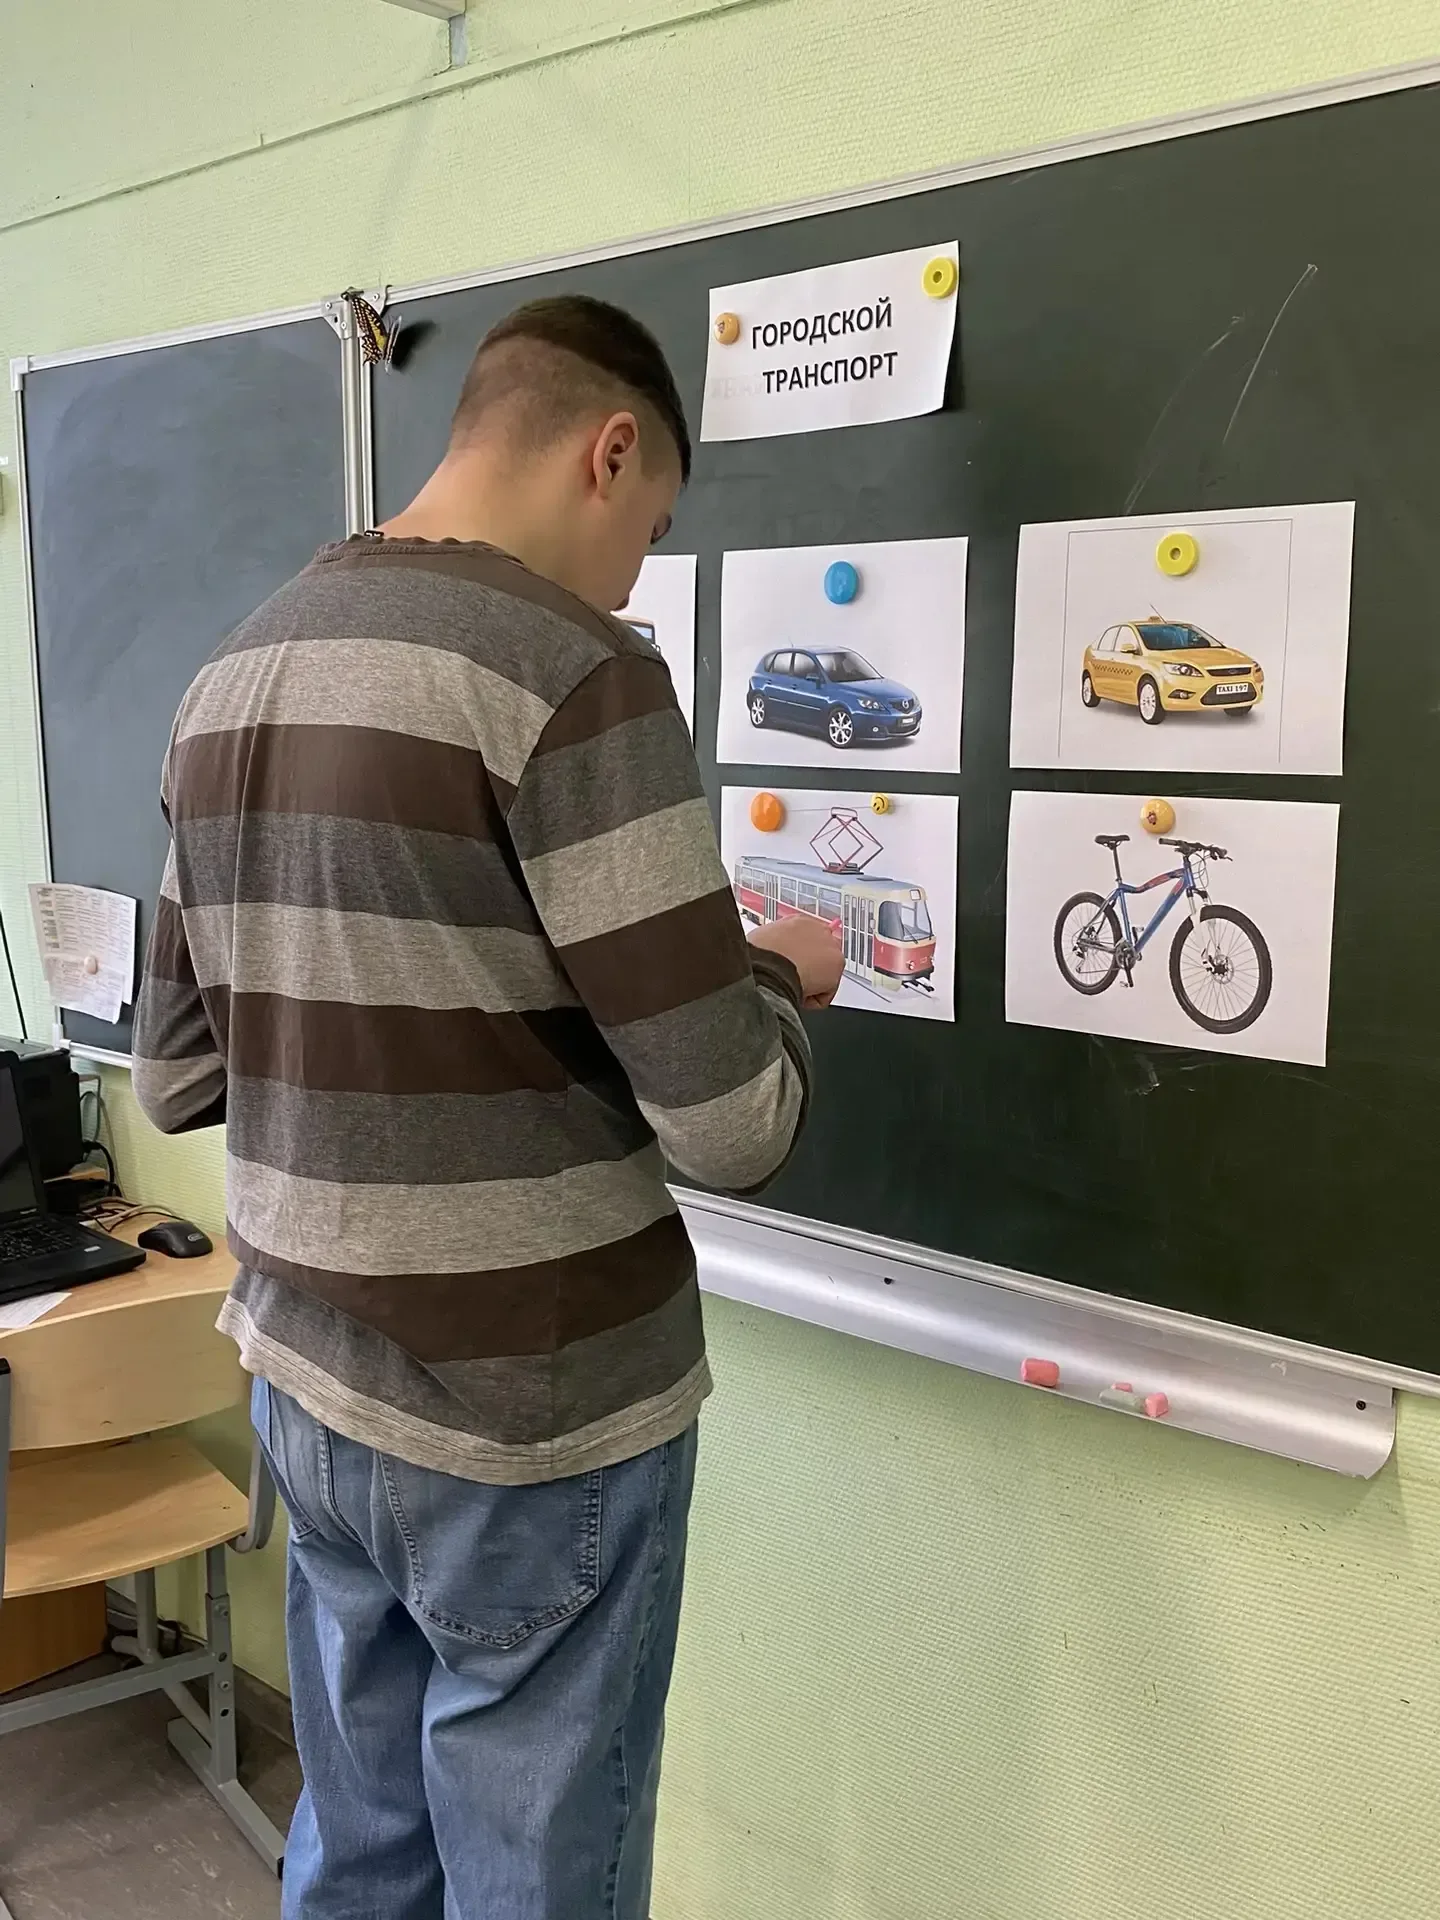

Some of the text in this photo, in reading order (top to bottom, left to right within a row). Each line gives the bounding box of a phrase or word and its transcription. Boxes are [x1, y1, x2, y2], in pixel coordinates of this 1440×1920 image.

[752, 296, 892, 350] ГОРОДСКОЙ
[762, 351, 898, 394] ТРАНСПОРТ
[1235, 684, 1247, 692] 197
